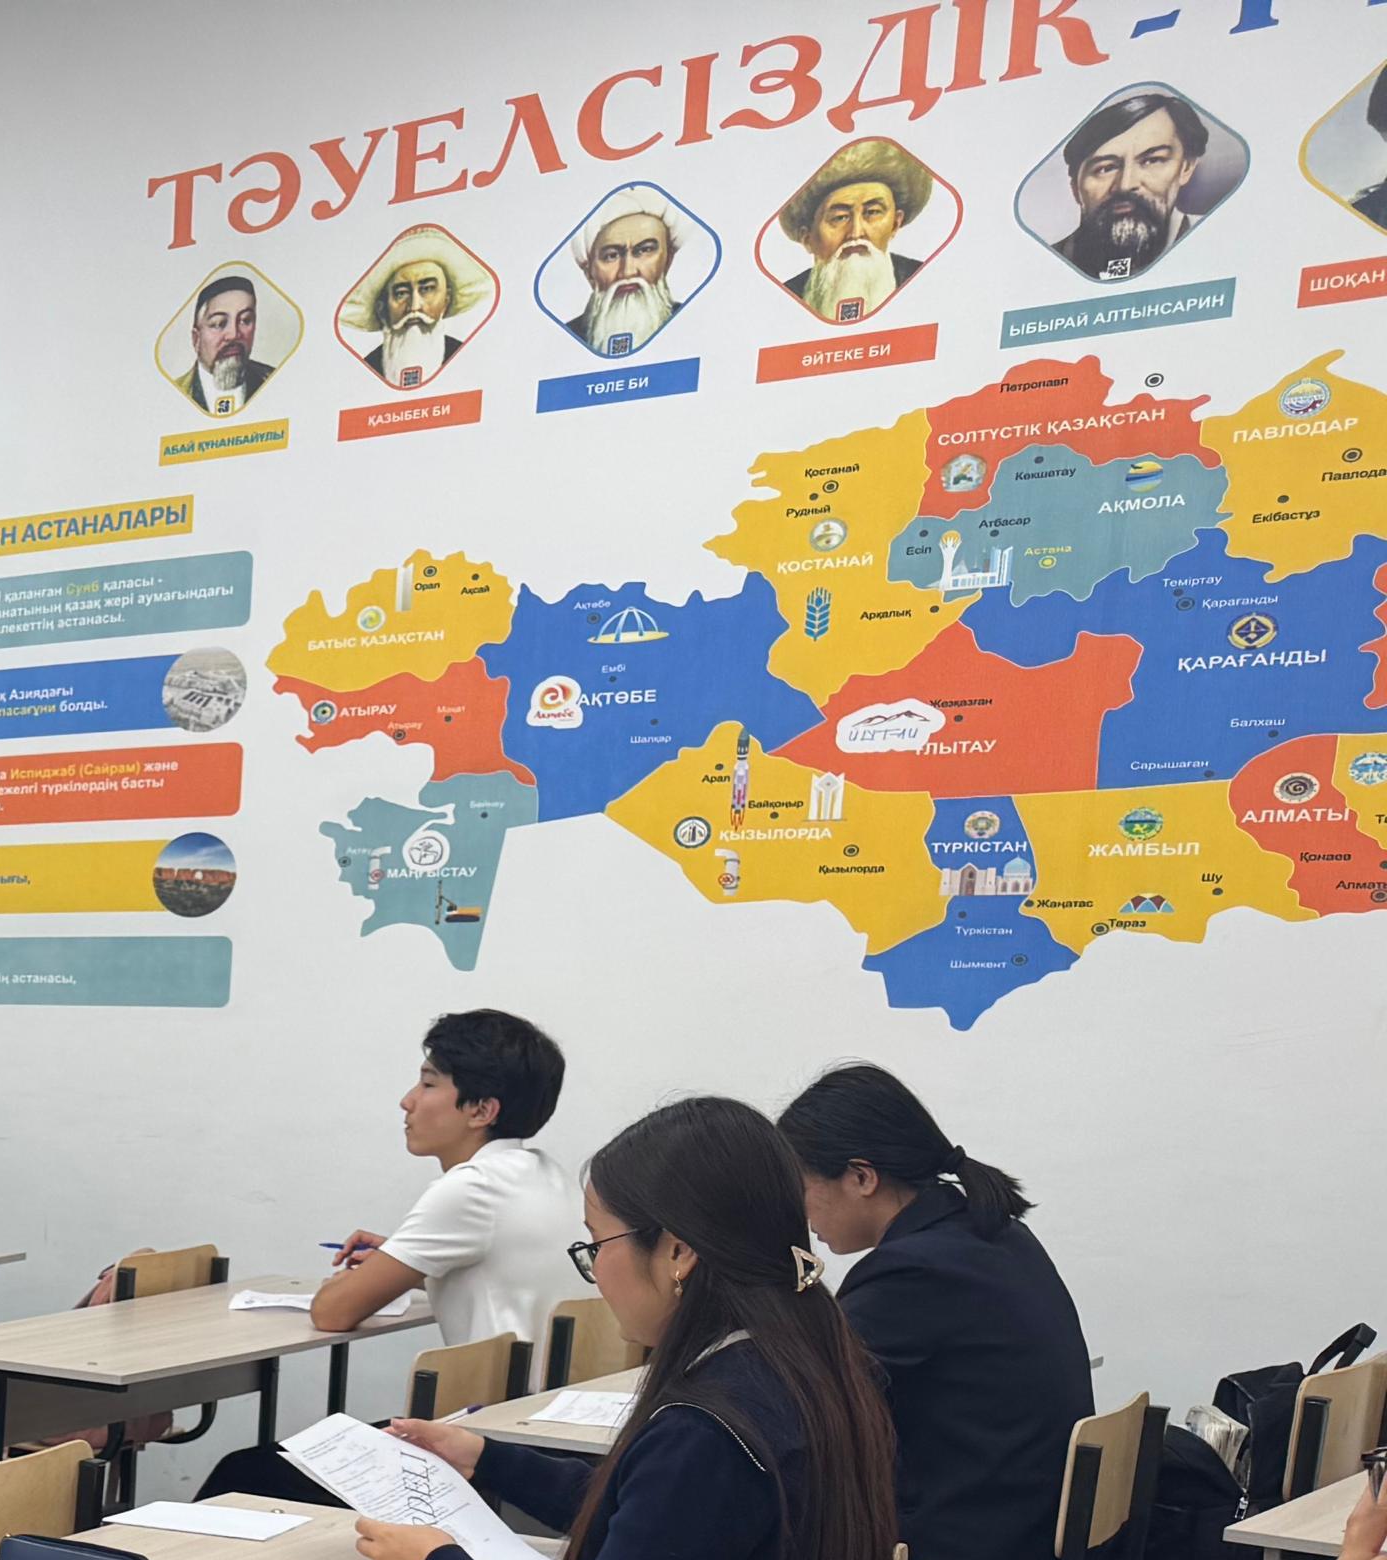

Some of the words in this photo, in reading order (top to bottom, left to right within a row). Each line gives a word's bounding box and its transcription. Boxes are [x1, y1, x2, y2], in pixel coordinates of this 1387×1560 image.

[147, 0, 1109, 250] ТӘУЕЛСІЗДІК
[1309, 269, 1386, 292] ШОҚАН
[1009, 311, 1089, 338] ЫБЫРАЙ
[1093, 294, 1225, 328] АЛТЫНСАРИН
[801, 346, 865, 367] ӘЙТЕКЕ
[868, 343, 891, 358] БИ
[585, 379, 625, 397] ТӨЛЕ
[627, 375, 649, 391] БИ
[1000, 377, 1069, 393] Петропавл
[367, 408, 429, 427] ҚАЗЫБЕК
[432, 404, 451, 417] БИ
[937, 423, 1042, 446] СОЛТҮСТІК
[1047, 408, 1166, 435] ҚАЗАҚСТАН
[1233, 418, 1359, 444] ПАВЛОДАР
[163, 439, 195, 456] АБАЙ
[804, 463, 860, 478] Қостанай
[1321, 468, 1387, 482] Павлода
[786, 504, 831, 518] Рудный
[1098, 494, 1186, 514] АҚМОЛА
[21, 504, 187, 542] АСТАНАЛАРЫ
[978, 516, 1031, 528] Атбасар
[1024, 545, 1072, 557] Астана
[777, 552, 874, 575] ҚОСТАНАЙ
[103, 577, 154, 592] қаласы
[414, 582, 440, 592] Орал
[1162, 575, 1222, 588] Теміртау
[65, 599, 101, 613] қазақ
[104, 593, 134, 608] жері
[860, 609, 912, 621] Арқалық
[308, 638, 356, 651] БАТЫС
[361, 630, 444, 648] ҚАЗАҚСТАН
[601, 663, 626, 674] Ембі
[1178, 649, 1327, 673] ҚАРАҒАНДЫ
[577, 689, 657, 708] АҚТӨБЕ
[339, 704, 397, 718] АТЫРАУ
[1230, 717, 1286, 728] Балхаш
[630, 734, 671, 744] Шалқар
[915, 739, 997, 756] ЛЫТАУ
[10, 764, 76, 780] Испиджаб
[79, 761, 141, 778] (Сайрам)
[143, 760, 179, 773] және
[121, 776, 165, 790] басты
[701, 774, 731, 784] Арал
[1241, 807, 1350, 824] АЛМАТЫ
[719, 827, 832, 842] ҚЫЗЫЛОРДА
[931, 841, 1027, 854] ТҮРКІСТАН
[1087, 841, 1201, 858] ЖАМБЫЛ
[818, 864, 885, 875] Қызылорда
[1201, 873, 1223, 885] Шу
[1036, 899, 1094, 910] Жаңатас
[1108, 918, 1147, 929] Тараз
[955, 926, 1013, 937] Түркістан
[950, 960, 1007, 970] Шымкент
